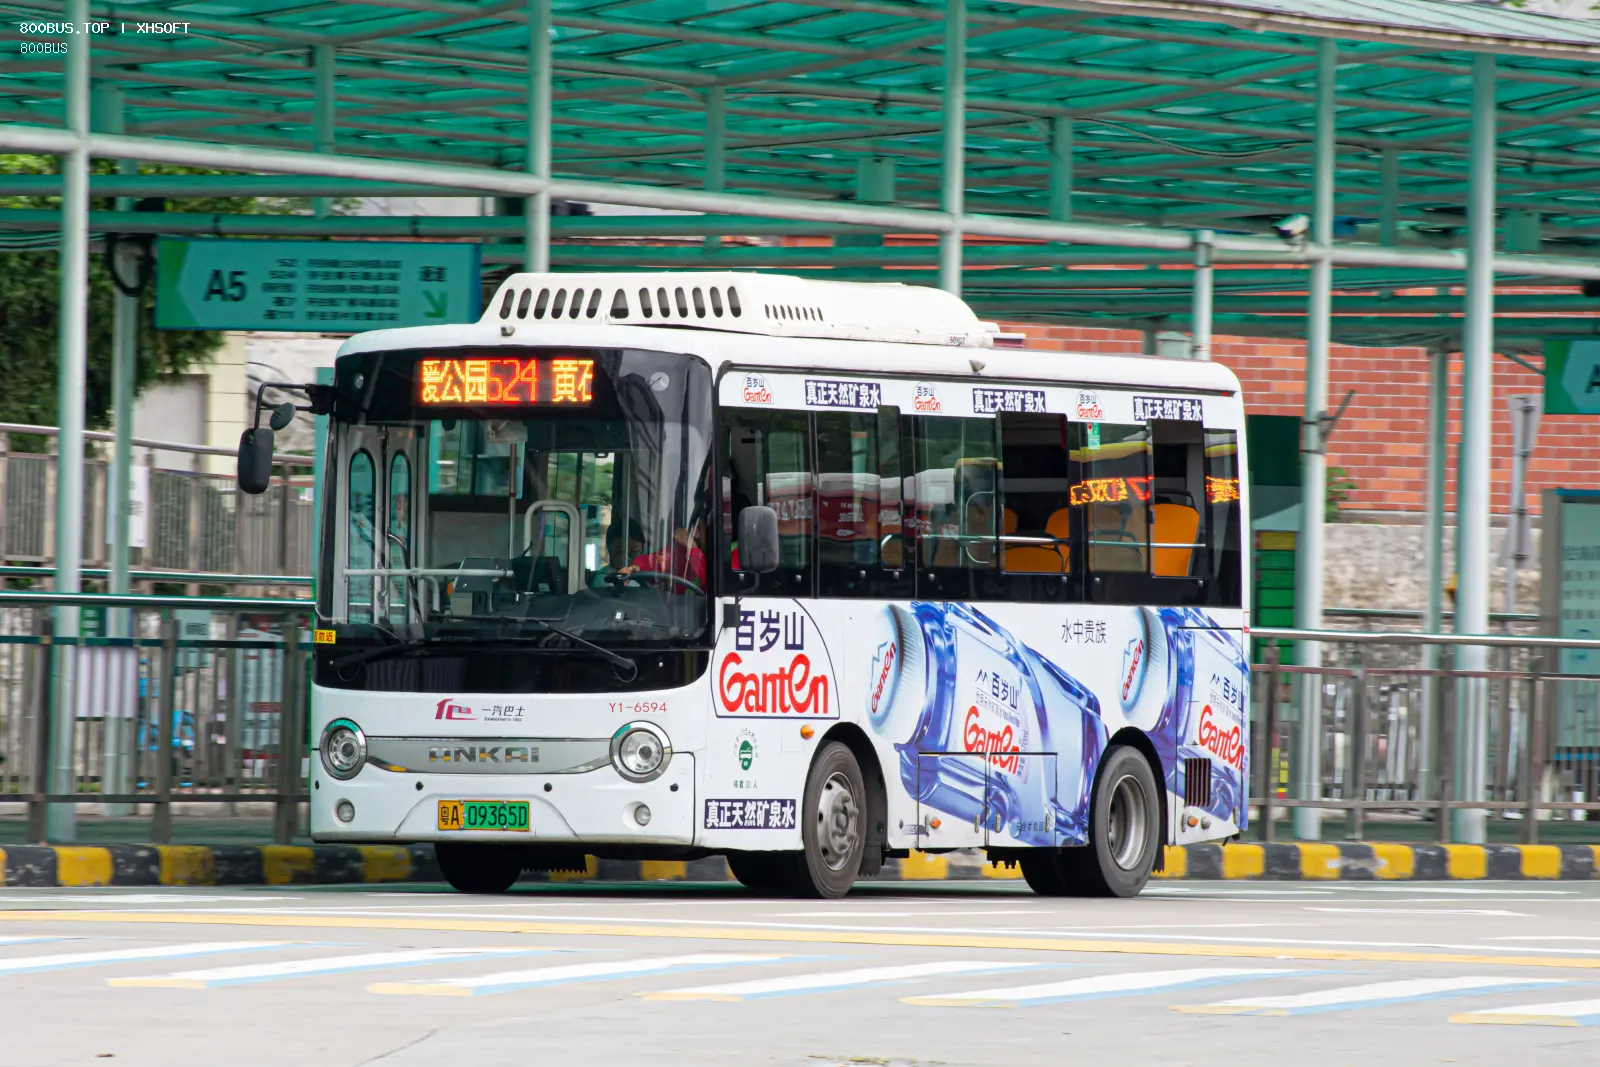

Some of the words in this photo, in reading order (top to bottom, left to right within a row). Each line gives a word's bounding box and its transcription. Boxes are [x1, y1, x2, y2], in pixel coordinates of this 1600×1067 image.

[203, 269, 247, 302] A5
[486, 359, 538, 403] 524
[746, 377, 765, 388] 百岁山
[916, 386, 935, 397] 百岁山
[806, 381, 880, 408] 真正天然矿泉水
[973, 389, 1046, 413] 真正天然矿泉水
[1079, 394, 1097, 404] 百岁山
[1134, 398, 1203, 421] 真正天然矿泉水
[735, 609, 805, 652] 百岁山
[1061, 618, 1107, 644] 水中贵族
[719, 651, 829, 714] Ganten
[991, 672, 1020, 710] 百岁山
[481, 704, 526, 717] 一汽巴士
[608, 702, 668, 713] Y1-6594
[428, 746, 540, 763] ANKAI
[440, 804, 460, 826] 粤A
[467, 805, 527, 827] 09365D
[706, 800, 795, 828] 真正天然矿泉水
